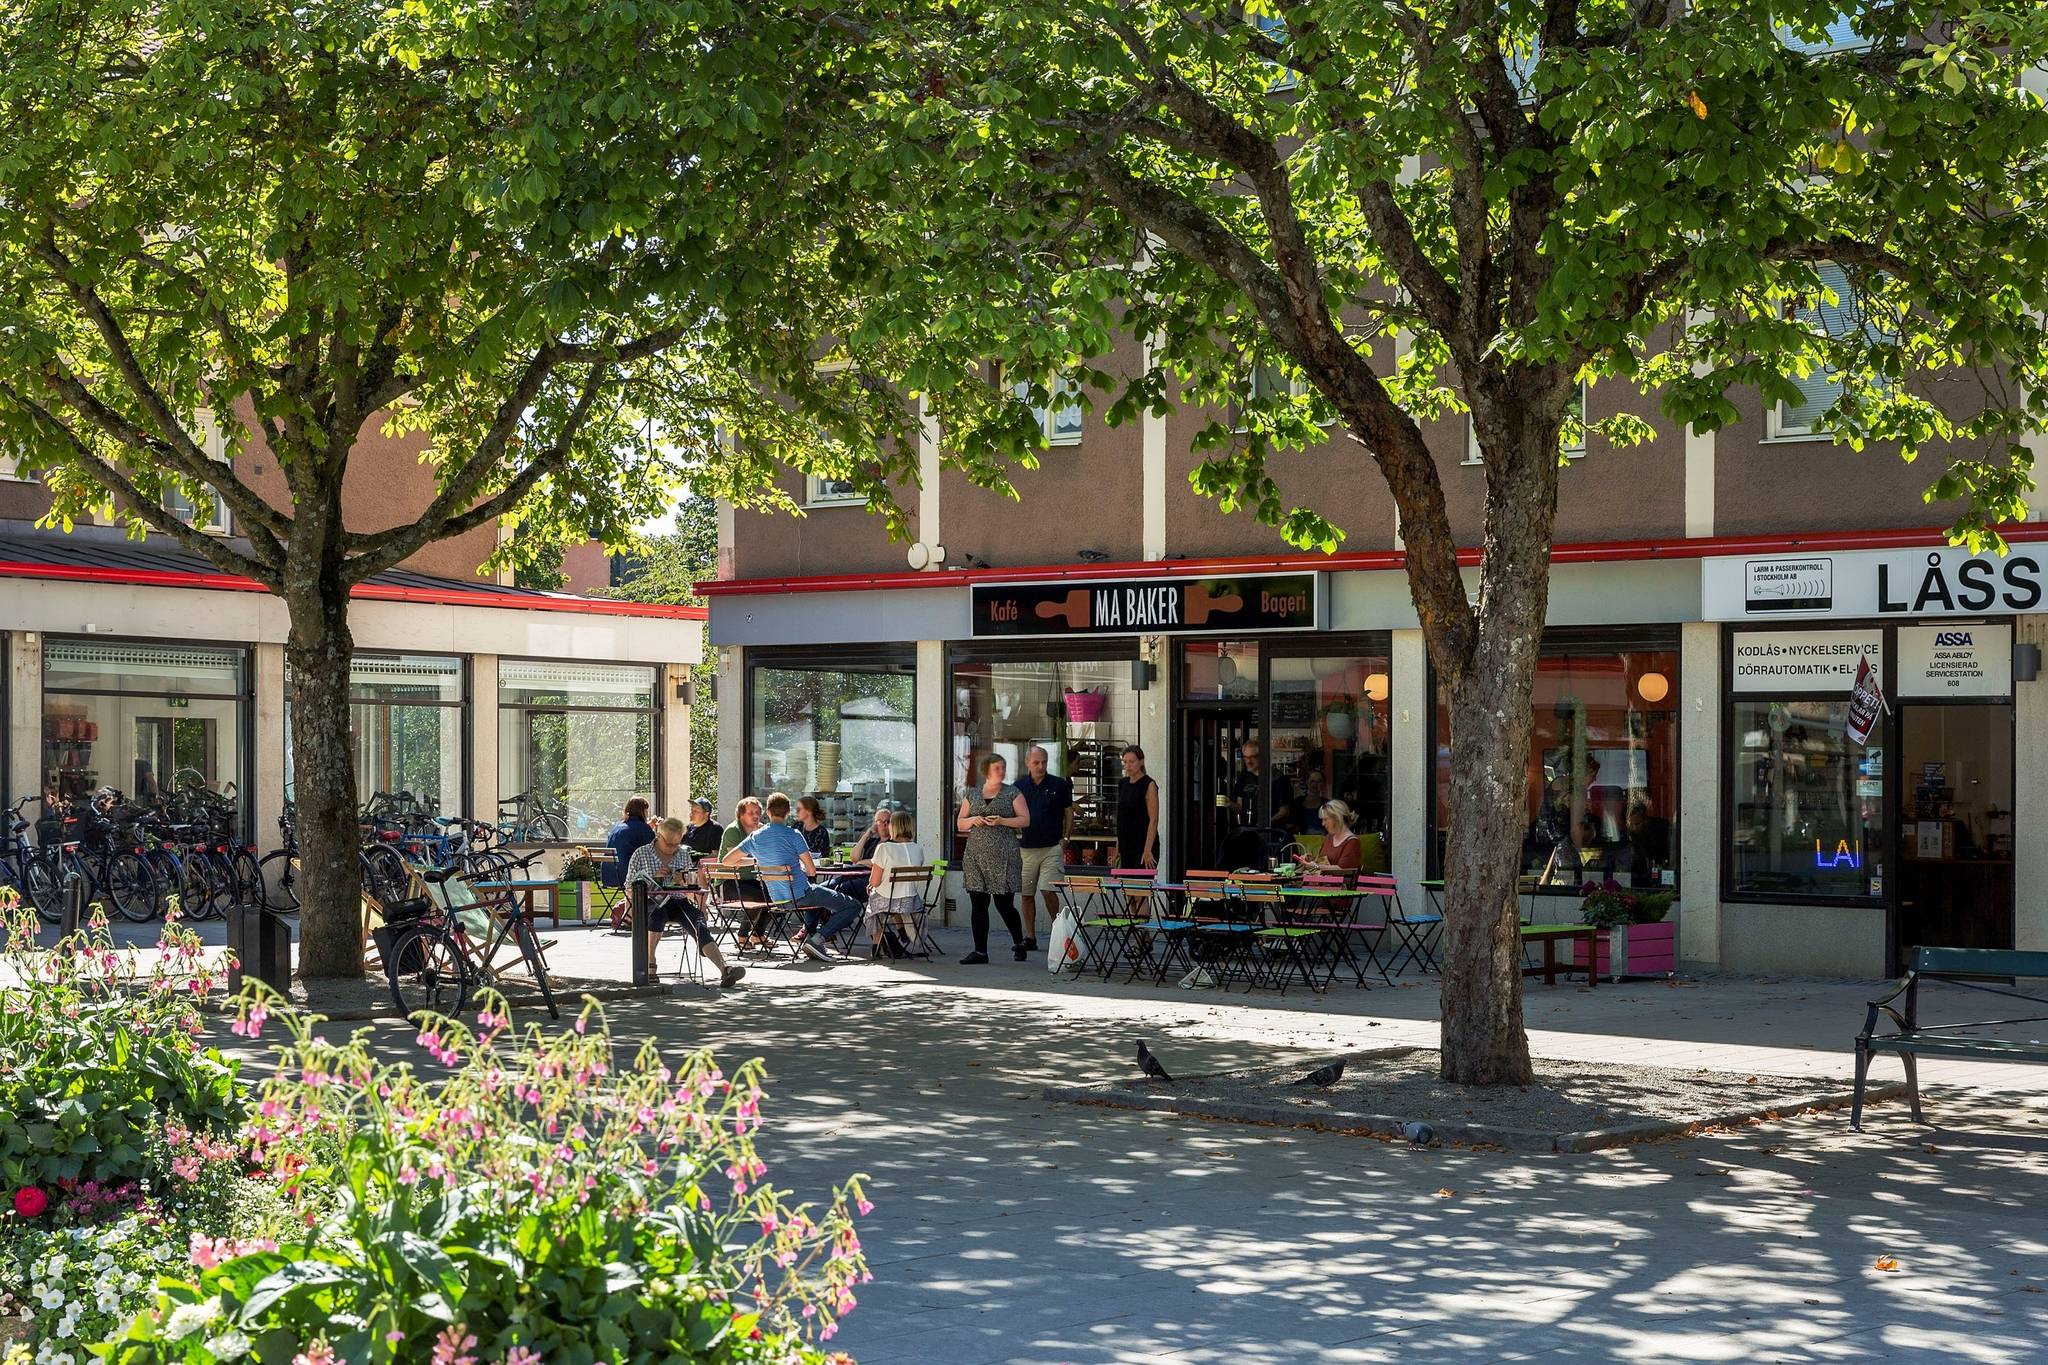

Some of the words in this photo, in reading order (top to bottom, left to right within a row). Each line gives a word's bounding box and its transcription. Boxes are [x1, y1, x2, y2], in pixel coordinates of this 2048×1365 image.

[1775, 564, 1823, 572] PASSERKONTROLL
[1757, 573, 1789, 581] STOCKHOLM
[1878, 552, 2042, 613] LÅSS
[1095, 590, 1121, 627] MA
[1126, 586, 1178, 626] BAKER
[1261, 590, 1306, 618] Bageri
[991, 600, 1018, 621] Kafé
[1934, 632, 1973, 646] ASSA
[1737, 644, 1781, 656] KODLÅS
[1738, 663, 1831, 675] DÖRRAUTOMATIK
[1839, 664, 1878, 675] EL-S
[1929, 661, 1978, 669] LICENSIERAD
[1925, 670, 1983, 678] SERVICESTATION
